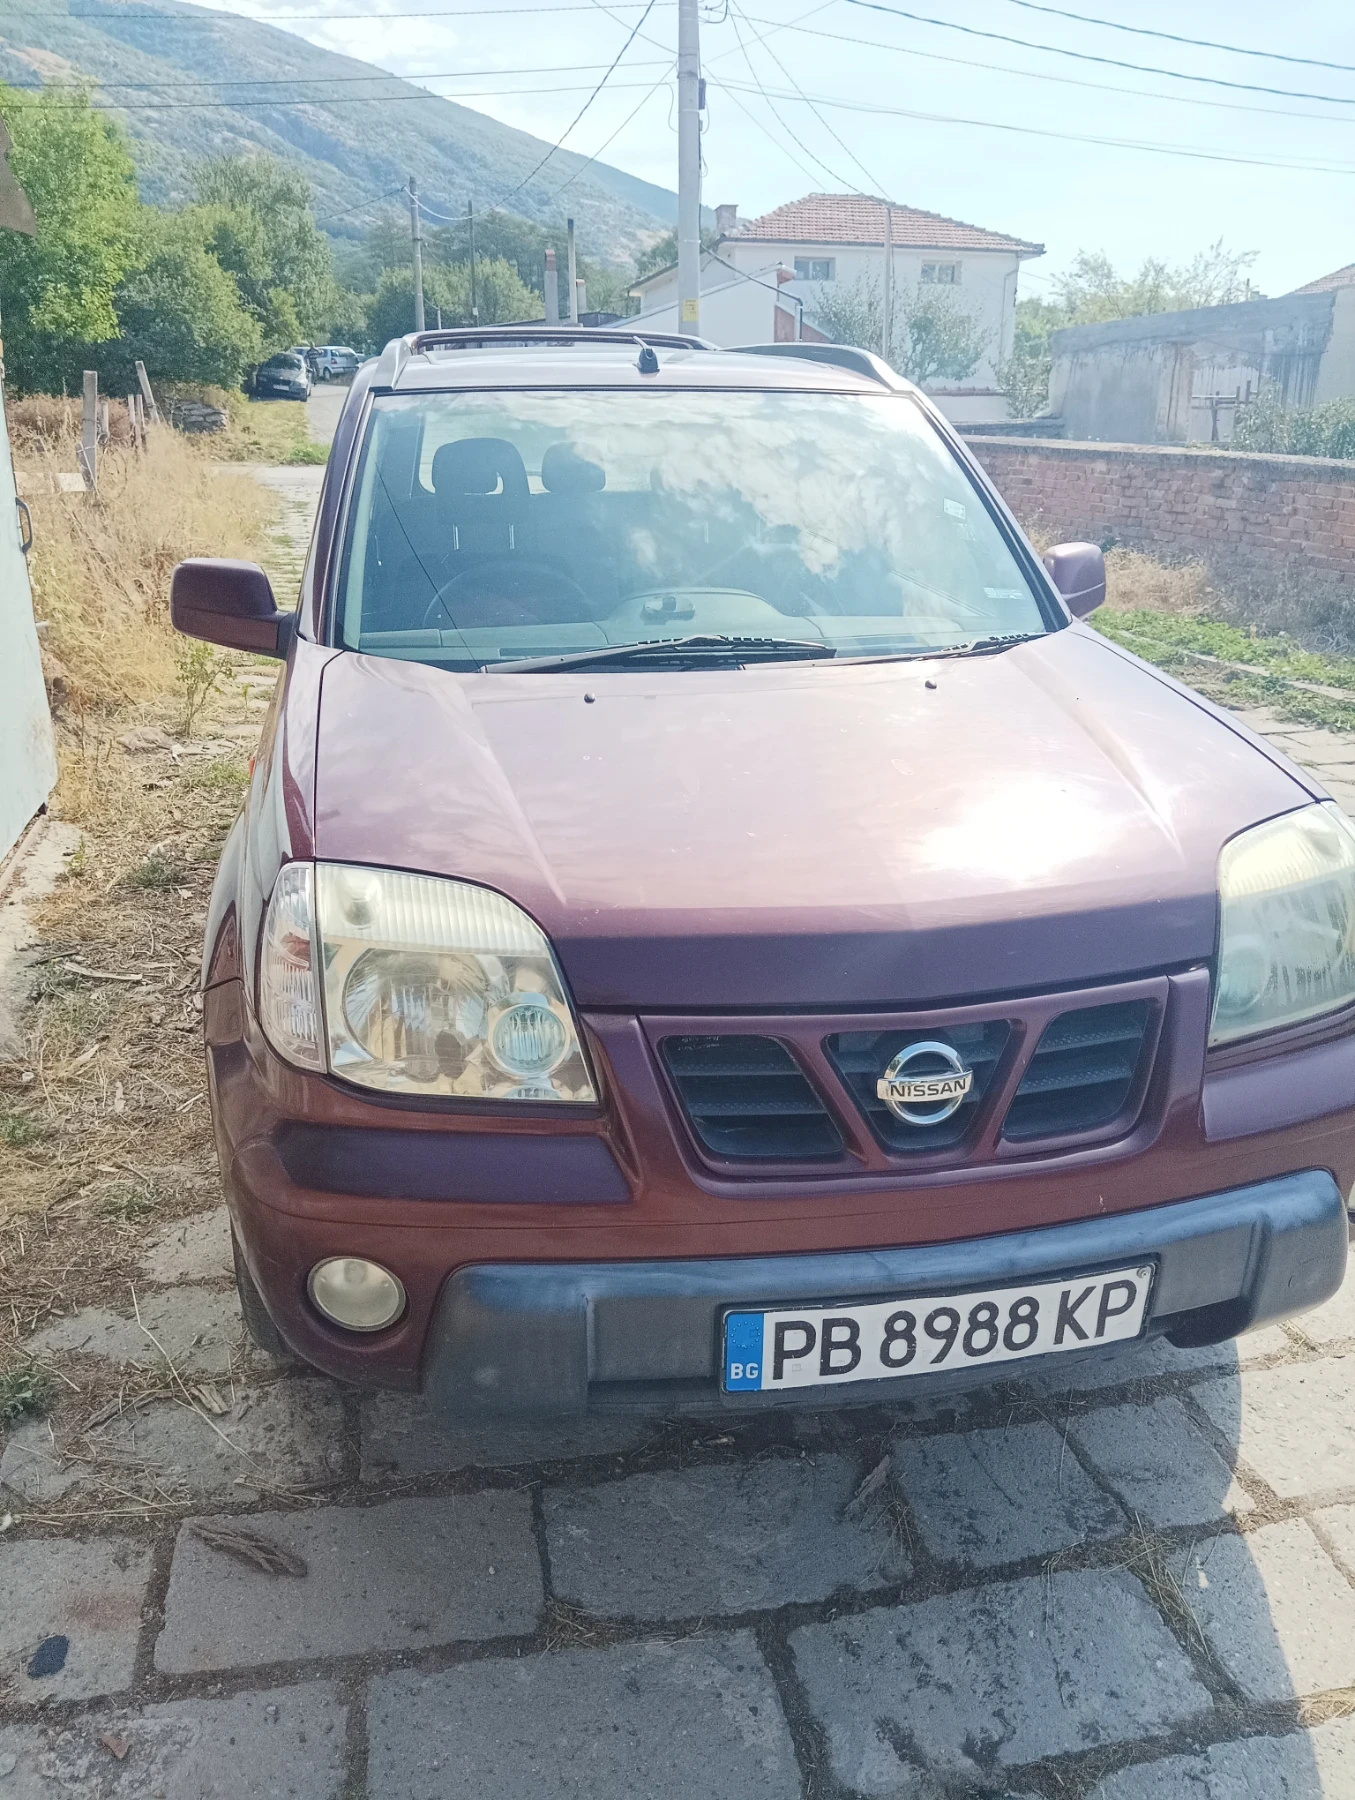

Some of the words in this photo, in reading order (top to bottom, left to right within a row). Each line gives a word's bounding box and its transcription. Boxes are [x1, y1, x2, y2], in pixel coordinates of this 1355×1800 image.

[890, 1077, 966, 1097] NISSAN
[772, 1317, 863, 1381] PB
[878, 1296, 1041, 1369] 8988
[1053, 1278, 1138, 1346] KP
[730, 1362, 759, 1380] BG
